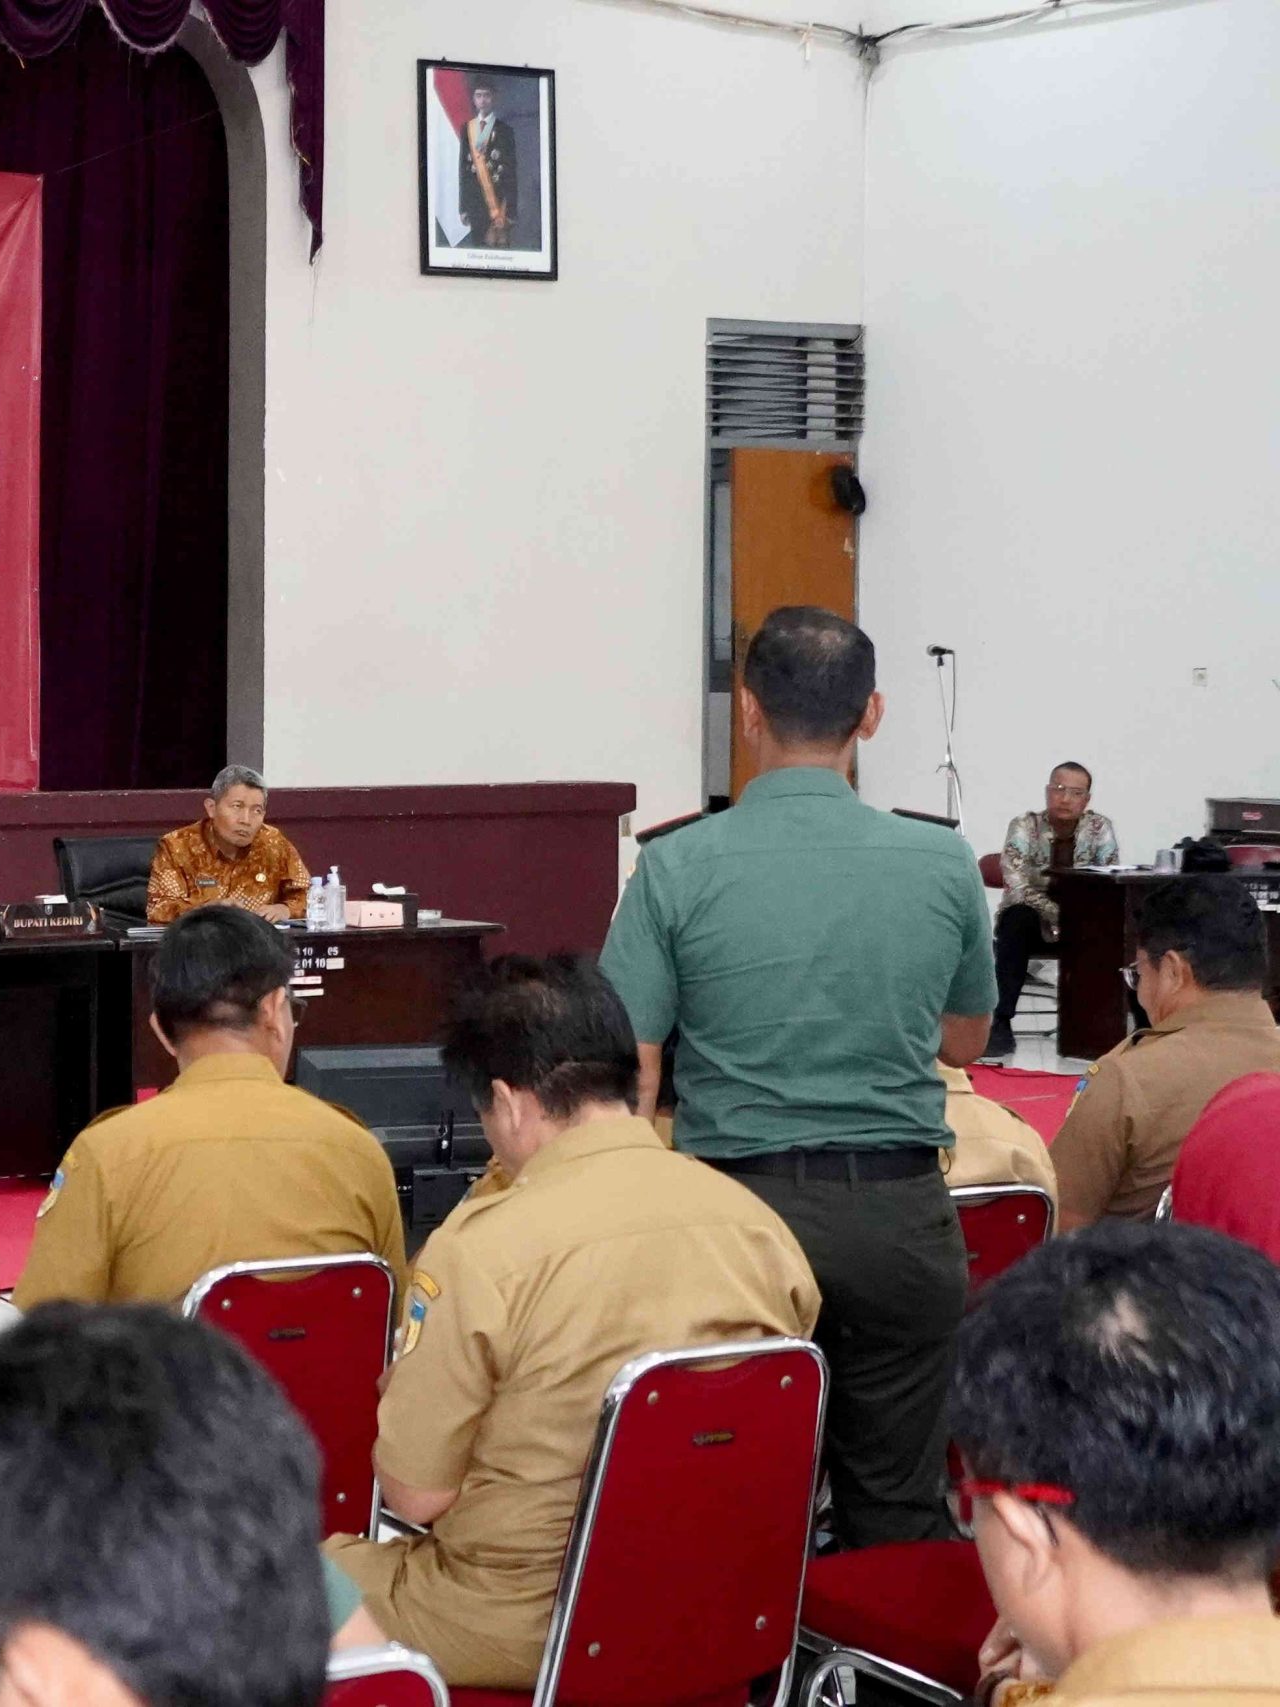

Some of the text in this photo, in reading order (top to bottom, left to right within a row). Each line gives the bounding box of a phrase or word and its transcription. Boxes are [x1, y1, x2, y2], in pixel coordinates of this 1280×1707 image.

[13, 916, 83, 928] BUPATI KEDIRI
[302, 958, 312, 968] 01
[315, 957, 326, 968] 10
